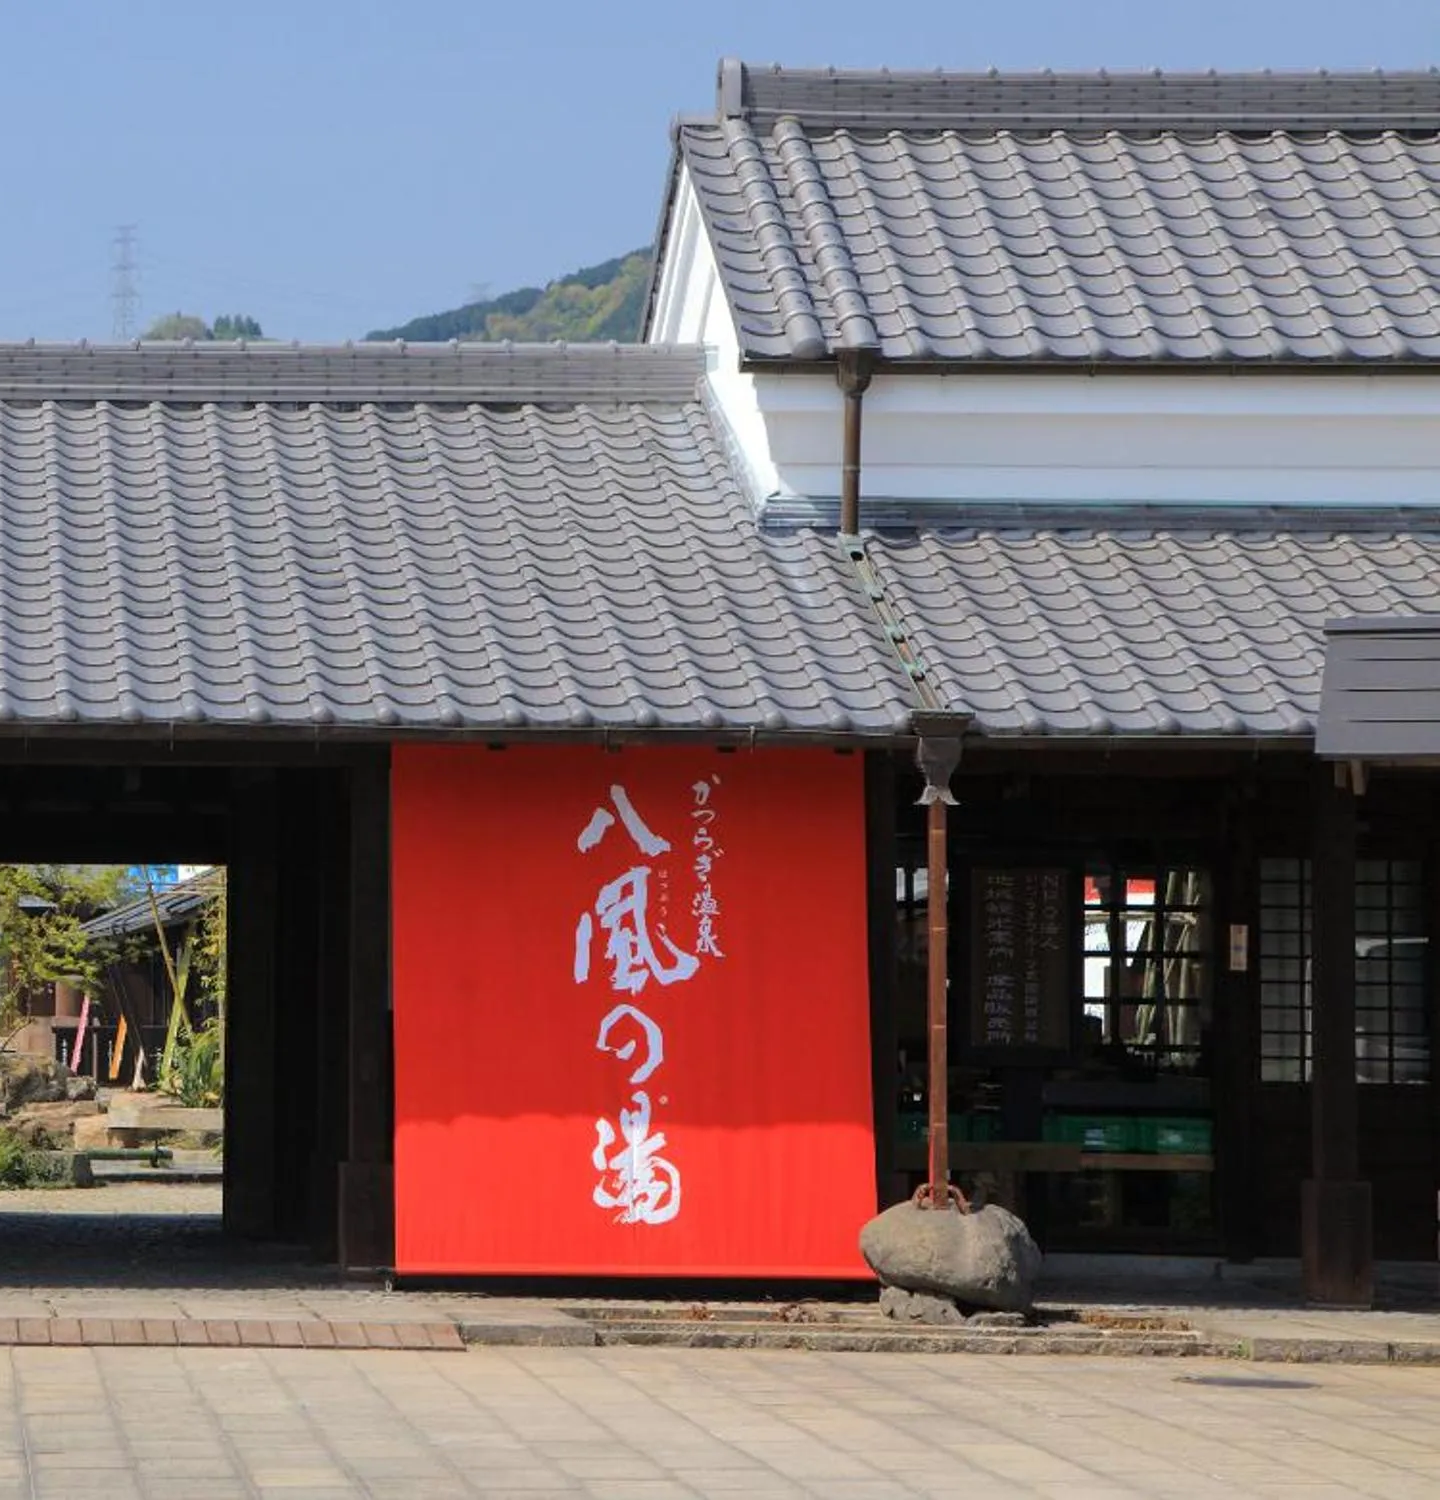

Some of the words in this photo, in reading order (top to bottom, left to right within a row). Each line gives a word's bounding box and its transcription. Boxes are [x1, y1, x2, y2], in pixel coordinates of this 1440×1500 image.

[574, 784, 700, 1224] 八風の湯
[691, 774, 726, 958] かつらぎ温泉
